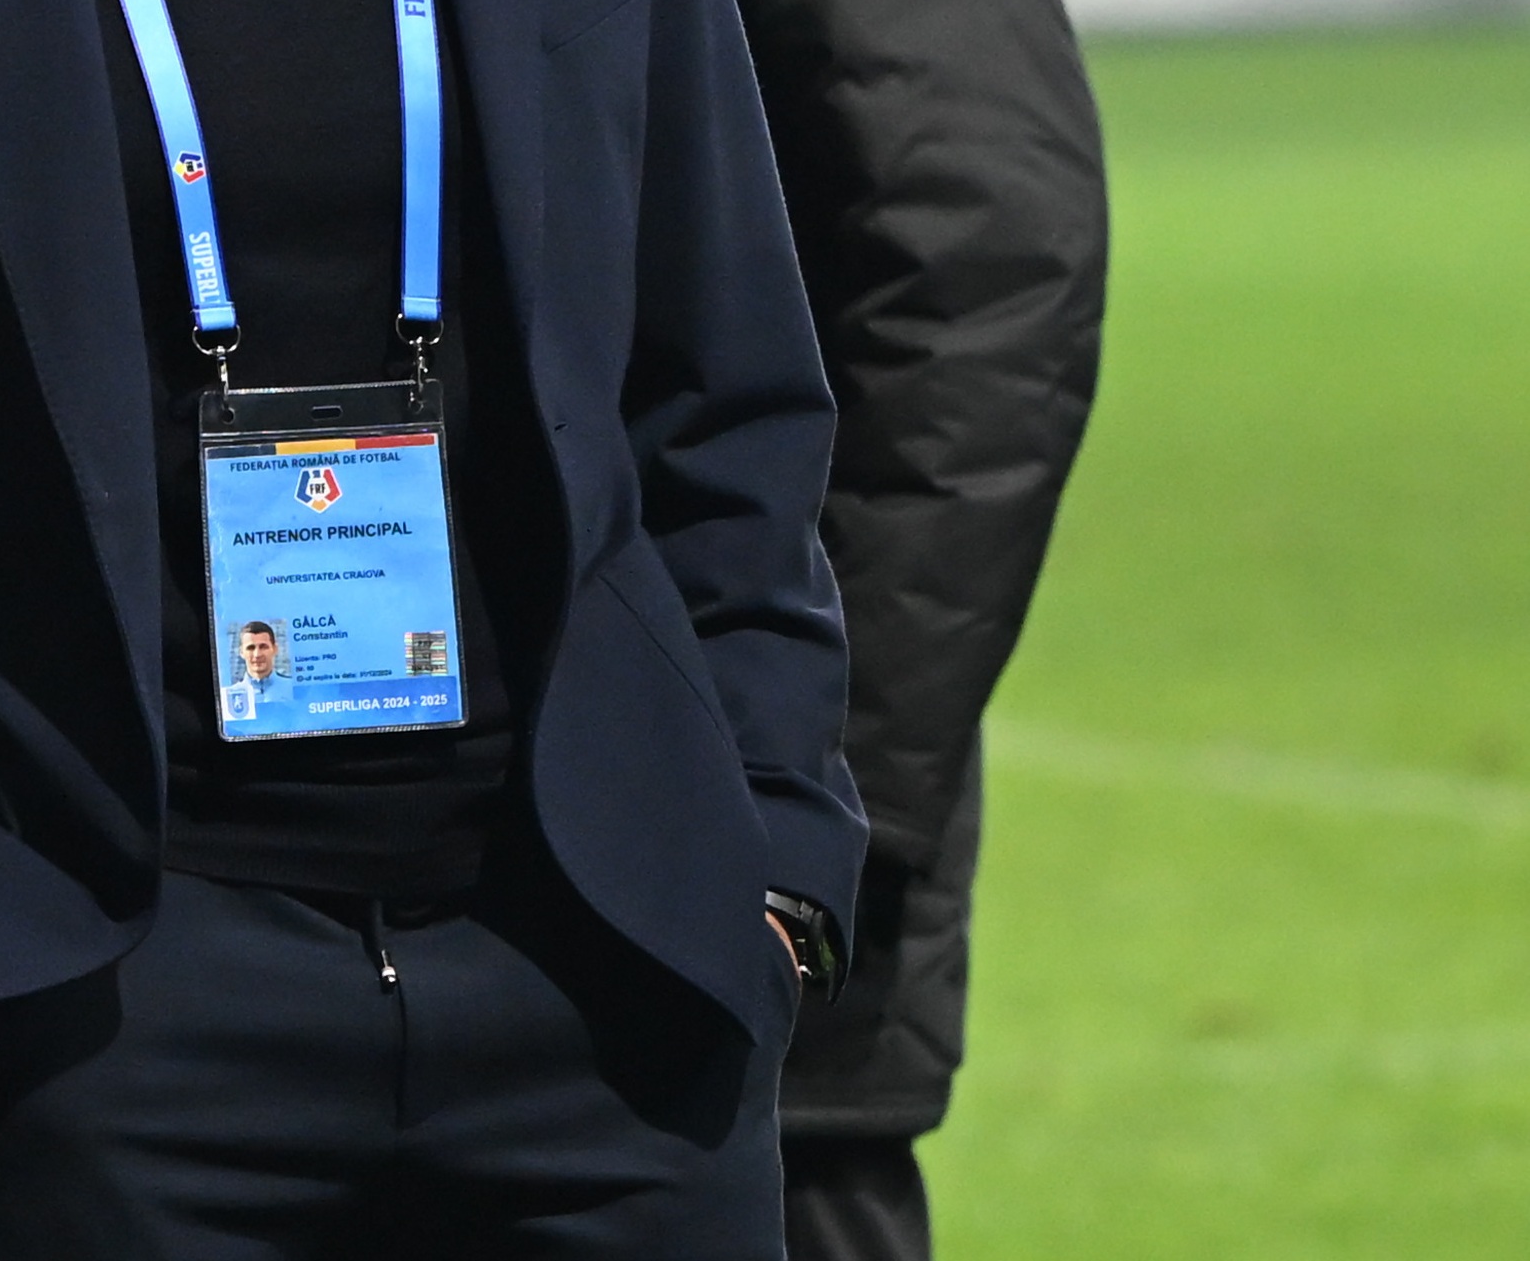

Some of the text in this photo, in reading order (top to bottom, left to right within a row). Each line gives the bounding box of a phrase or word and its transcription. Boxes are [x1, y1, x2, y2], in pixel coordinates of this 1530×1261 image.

[189, 231, 221, 304] SUPERL
[230, 451, 401, 473] FEDERAȚIA ROMÂNĂ DE FOTBAL
[310, 483, 325, 495] FRF
[232, 521, 412, 546] ANTRENOR PRINCIPAL
[266, 569, 386, 585] UNIVERSITATEA CRAIOVA
[293, 631, 348, 642] Constantin
[308, 701, 380, 714] SUPERLIGA
[383, 697, 411, 709] 2024
[420, 694, 448, 706] 2025
